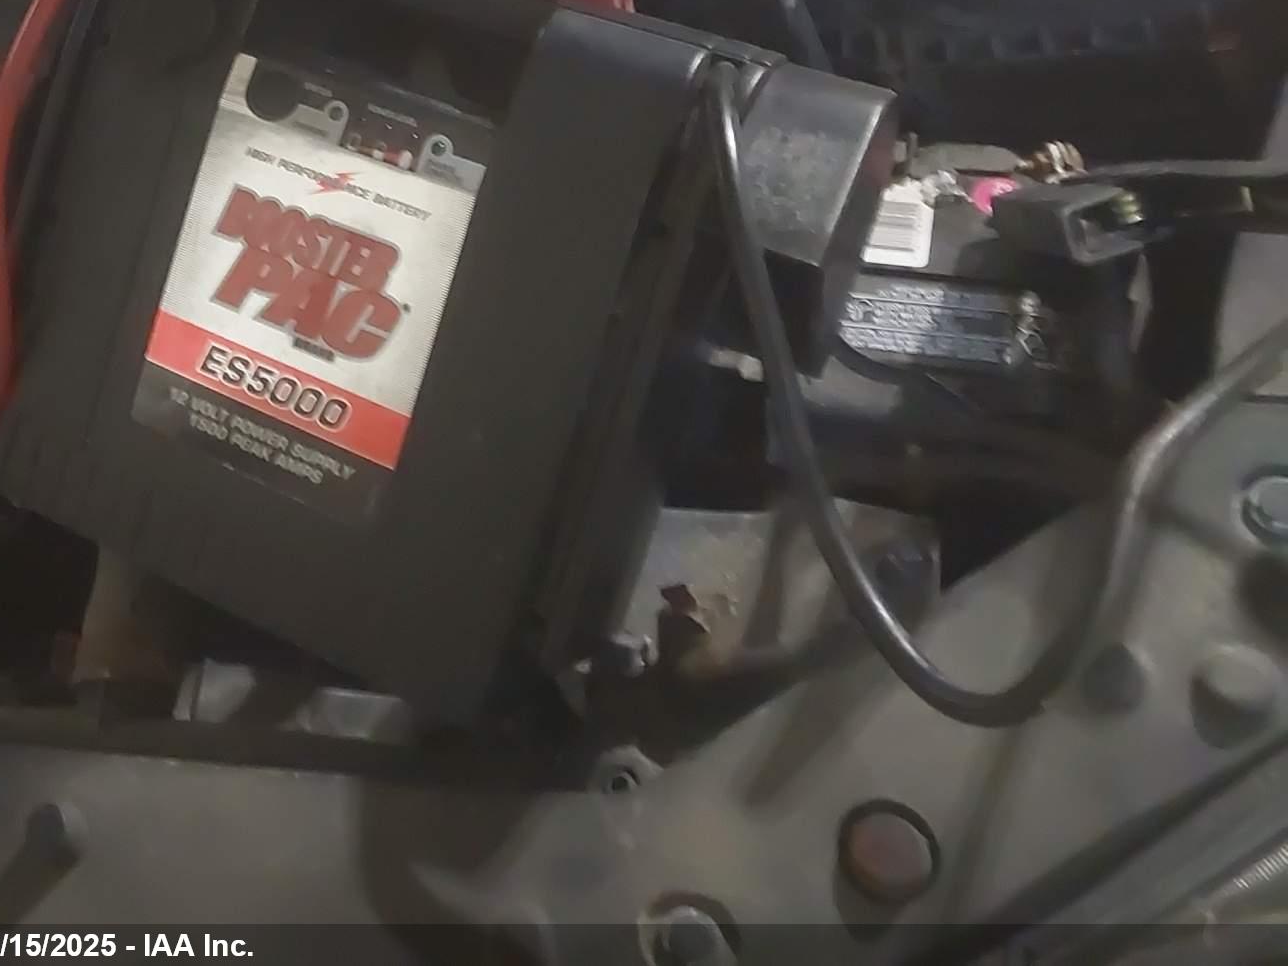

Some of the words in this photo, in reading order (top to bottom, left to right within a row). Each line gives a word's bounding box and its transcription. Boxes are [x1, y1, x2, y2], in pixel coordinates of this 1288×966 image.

[277, 157, 370, 201] PERFORNCE
[372, 192, 432, 222] BATTERY
[212, 183, 401, 291] BOOSTER
[210, 241, 402, 362] PAC
[169, 385, 189, 407] 12
[190, 392, 229, 424] VOLT
[230, 415, 289, 451] POWER
[290, 442, 356, 480] SUPPLY
[198, 343, 352, 431] ES5000
[229, 433, 272, 461] PEAK
[274, 452, 324, 484] AMPS
